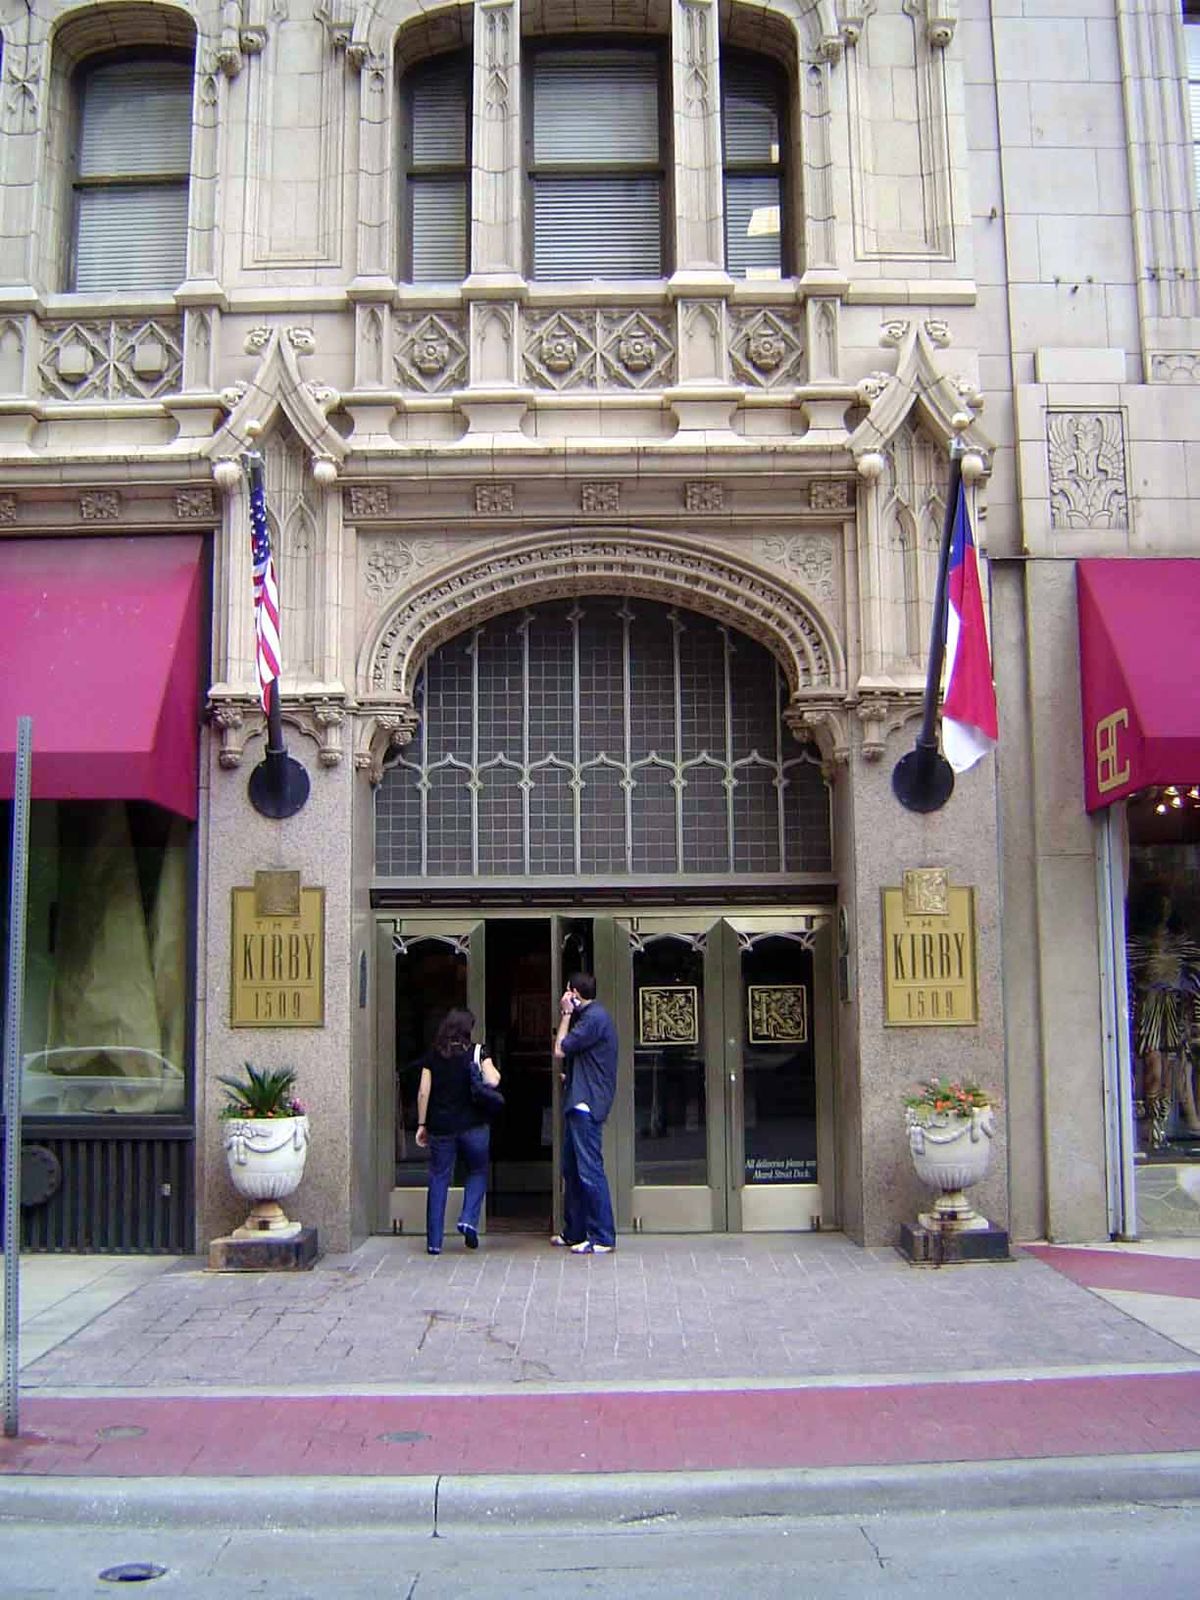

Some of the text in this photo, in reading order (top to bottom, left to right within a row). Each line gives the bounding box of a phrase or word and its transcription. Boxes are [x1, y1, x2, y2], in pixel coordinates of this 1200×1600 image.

[256, 921, 301, 930] THE
[243, 933, 315, 980] KIRBY
[893, 932, 965, 980] KIRBY
[255, 991, 301, 1019] 1509
[907, 990, 953, 1019] 1509
